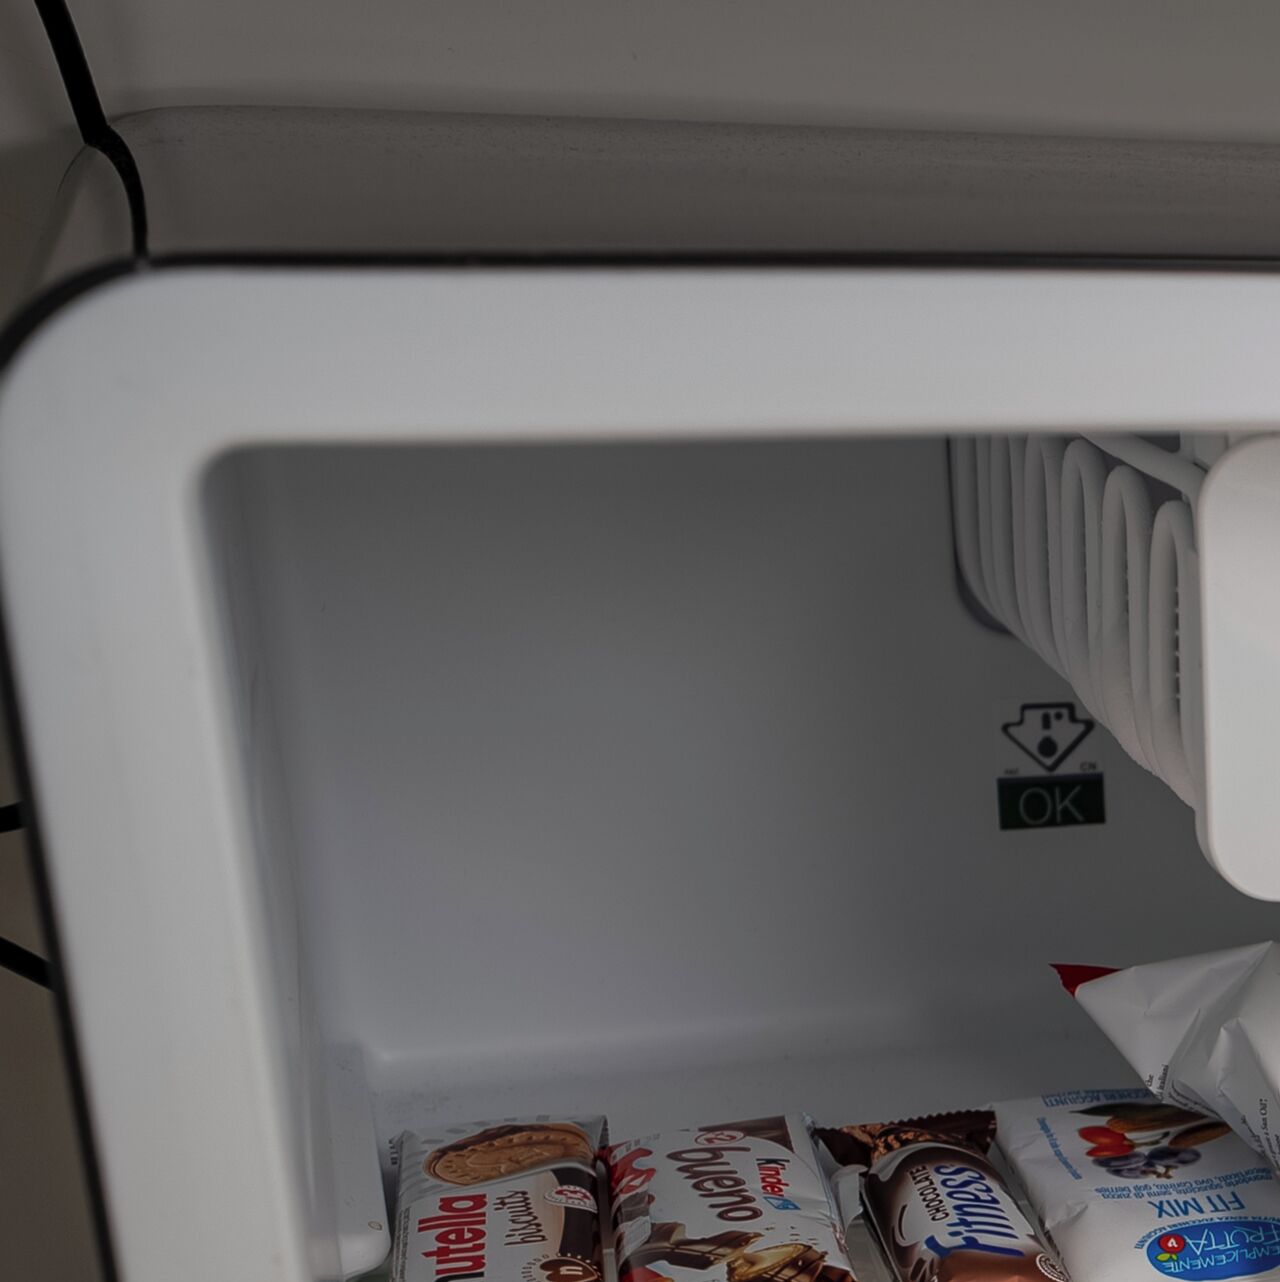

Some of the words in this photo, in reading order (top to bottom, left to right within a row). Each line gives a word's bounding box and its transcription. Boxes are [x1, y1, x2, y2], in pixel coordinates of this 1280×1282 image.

[1018, 784, 1085, 825] OK
[666, 1146, 763, 1222] bueno
[908, 1165, 950, 1222] CHOCOLATE
[924, 1164, 1025, 1259] Fitness
[1148, 1196, 1205, 1219] MIX
[1209, 1191, 1246, 1213] FIT
[493, 1190, 548, 1247] biscuits
